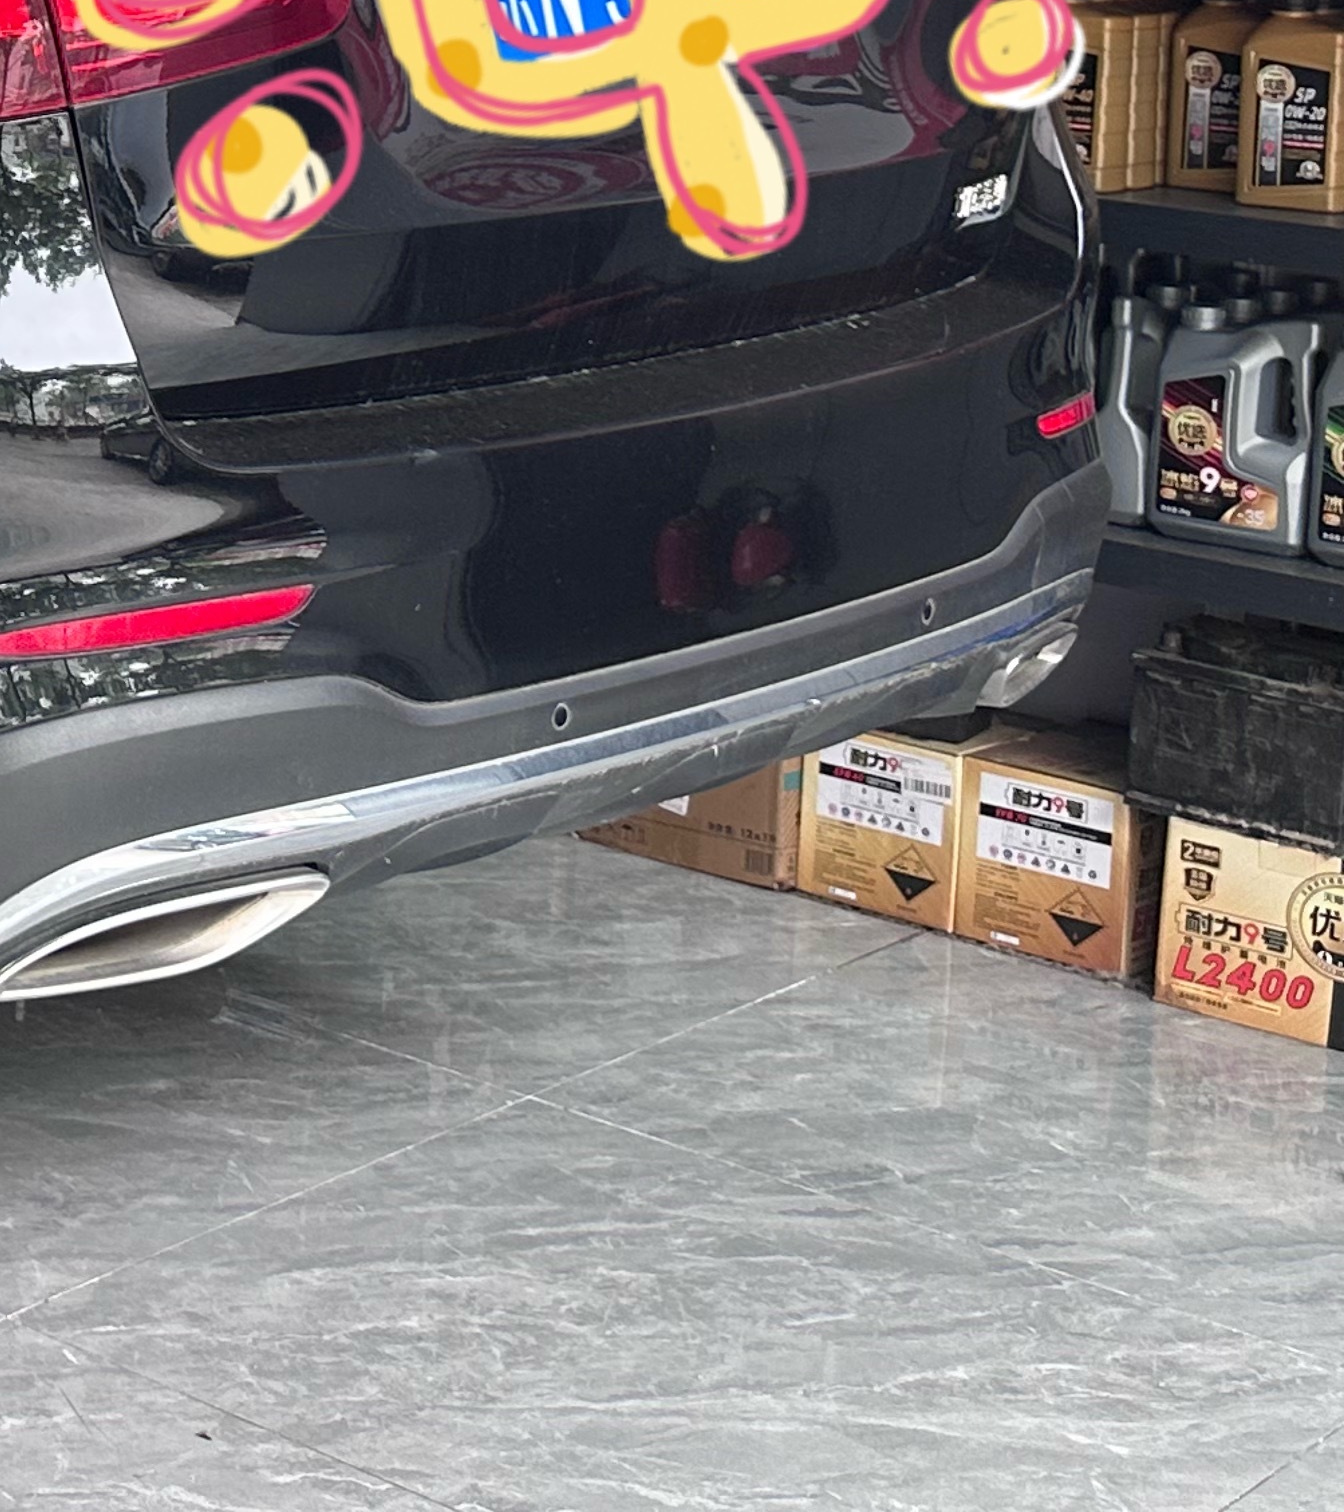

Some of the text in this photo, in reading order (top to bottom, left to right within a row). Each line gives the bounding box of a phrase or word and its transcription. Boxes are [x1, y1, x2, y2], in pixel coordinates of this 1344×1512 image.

[1293, 86, 1317, 104] SP
[1284, 103, 1328, 122] 0W-20
[850, 747, 900, 773] 耐力9
[1184, 908, 1289, 955] 耐力9号
[1170, 944, 1316, 1010] L2400
